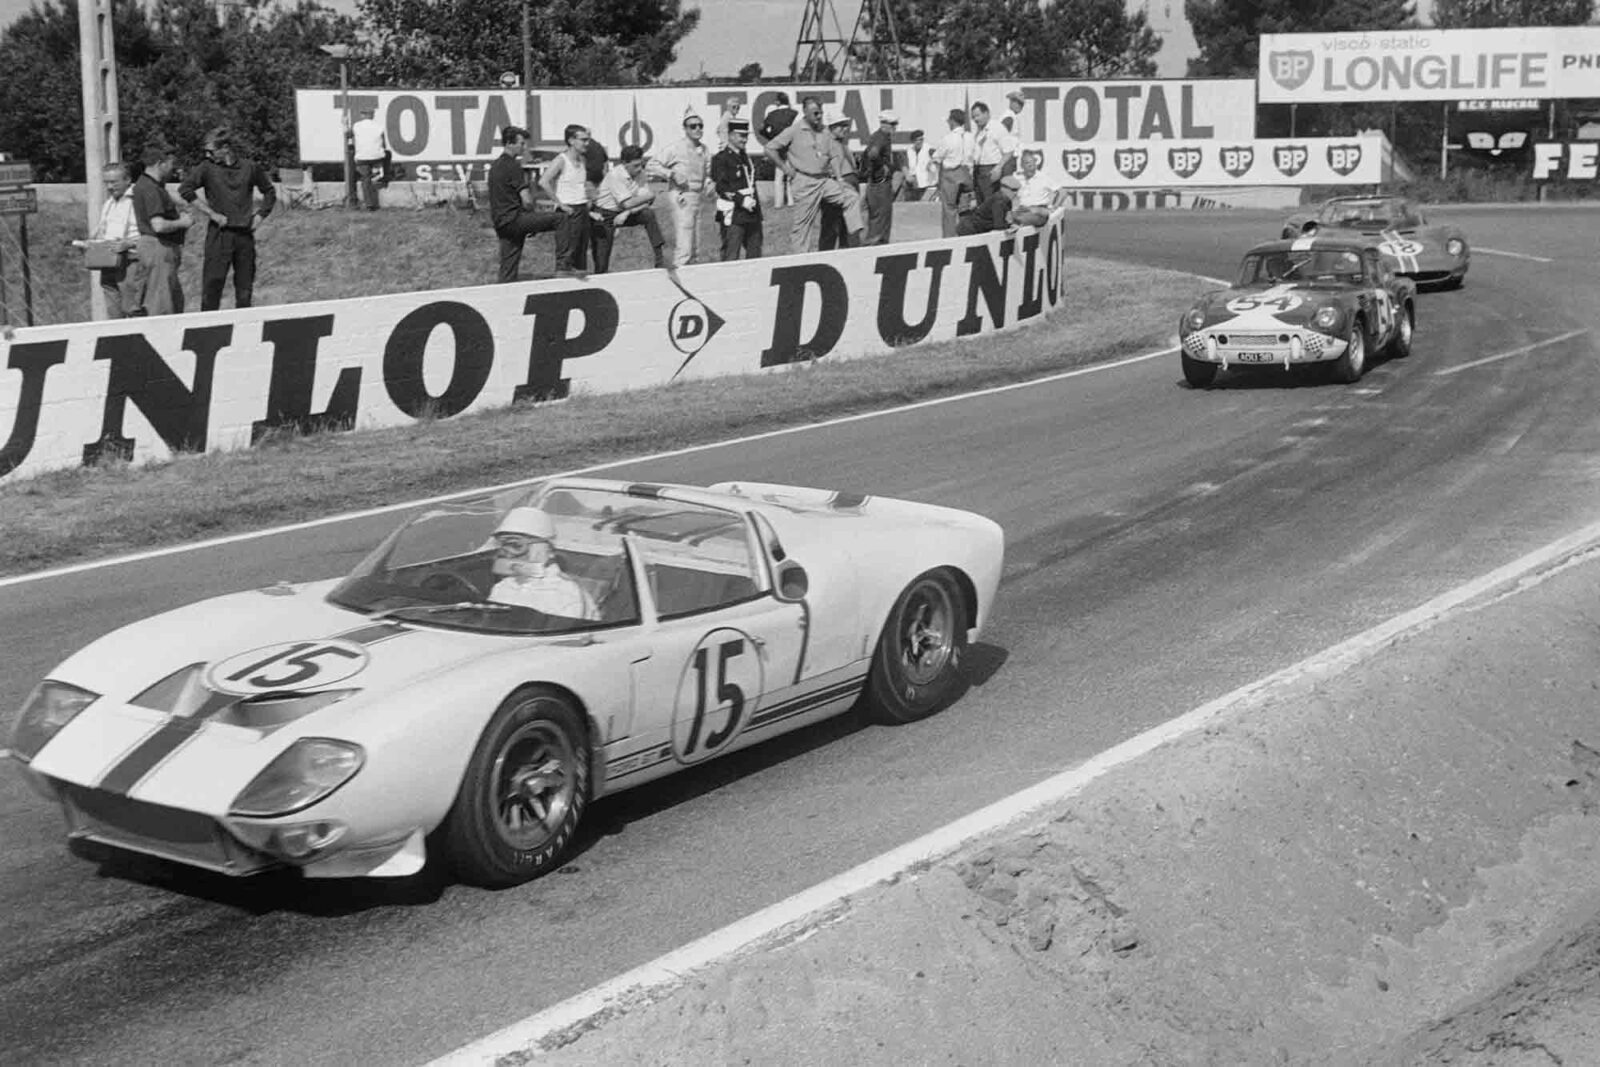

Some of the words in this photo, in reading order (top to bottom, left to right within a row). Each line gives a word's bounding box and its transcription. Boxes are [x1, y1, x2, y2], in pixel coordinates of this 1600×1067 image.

[1275, 55, 1309, 80] BP
[1323, 52, 1548, 91] LONGLIFE
[1021, 84, 1215, 142] TOTAL
[1066, 152, 1094, 172] BP
[1118, 151, 1147, 172] BP
[1172, 150, 1200, 171] BP
[1224, 150, 1252, 170] BP
[1278, 149, 1306, 169] BP
[1331, 148, 1360, 169] BP
[760, 223, 1064, 369] DUNLO
[1233, 295, 1293, 311] 54
[676, 314, 701, 341] D
[223, 642, 362, 688] 15
[682, 638, 745, 757] 15
